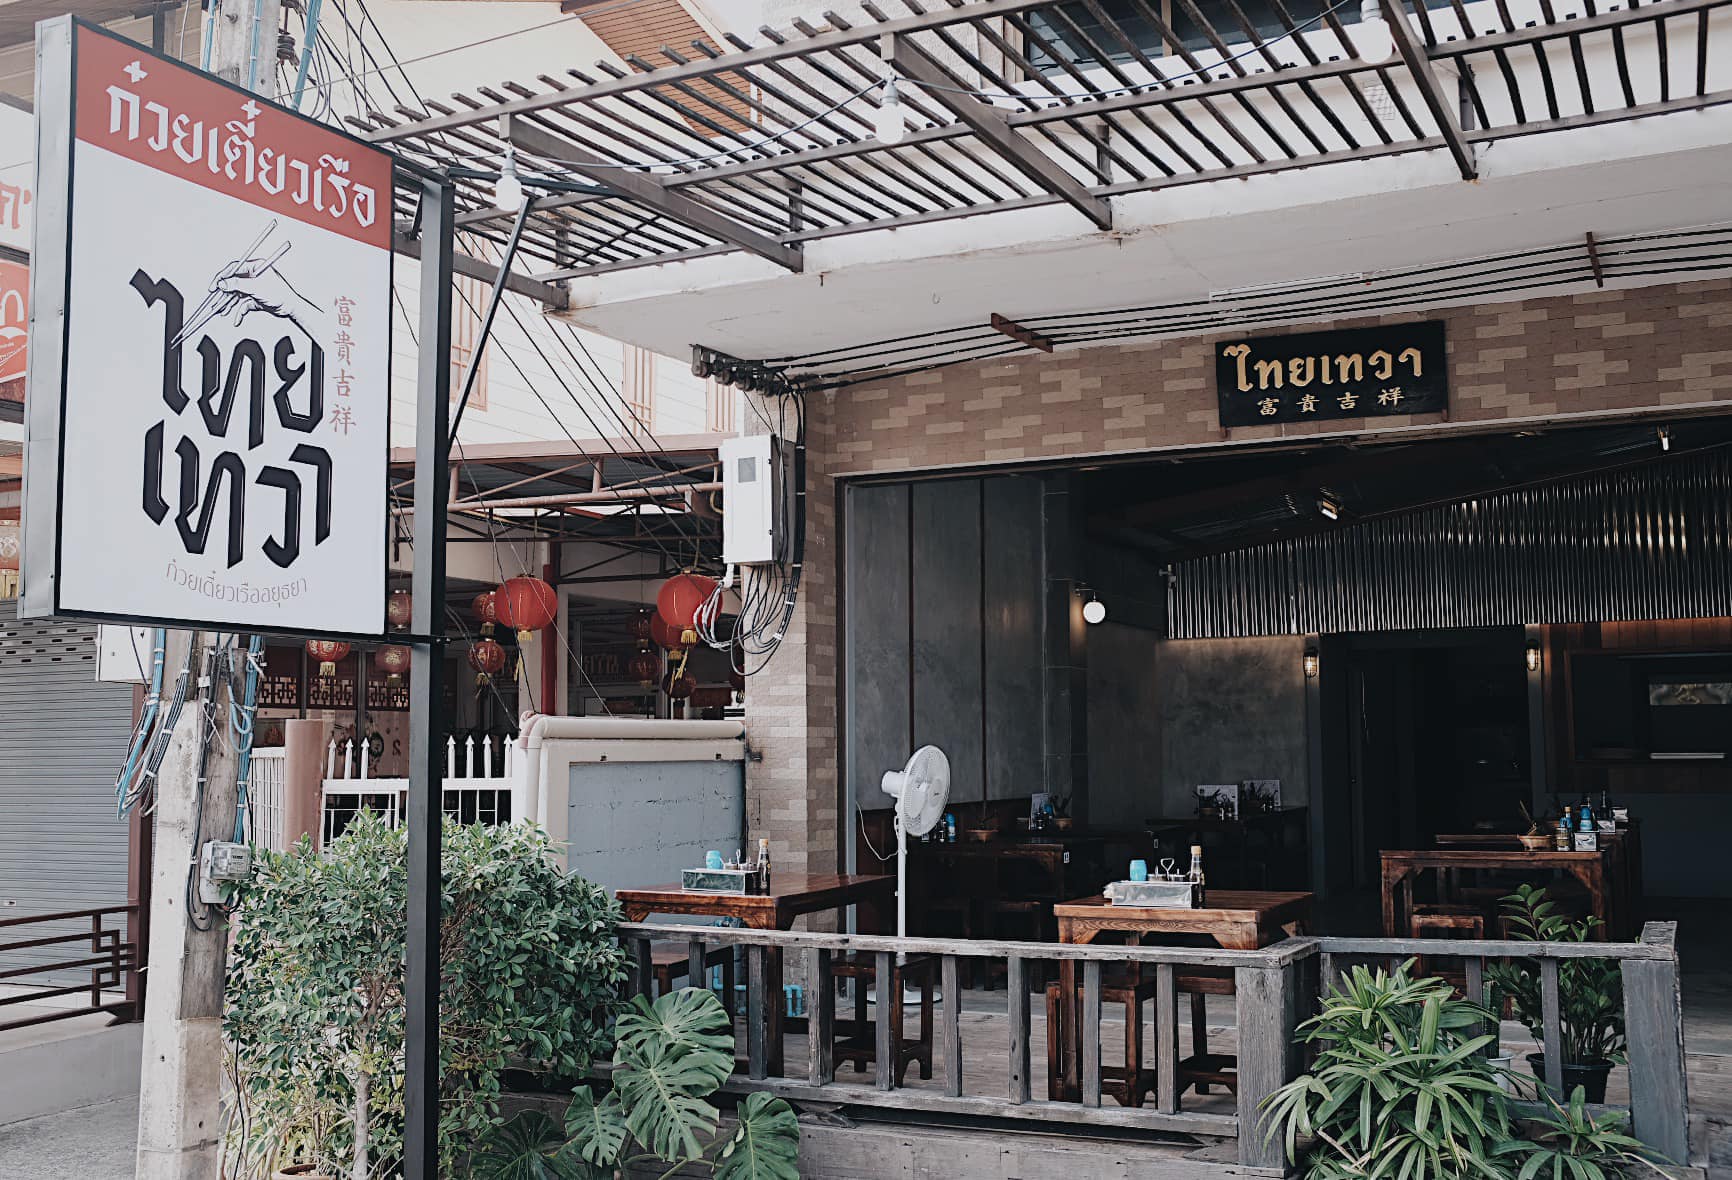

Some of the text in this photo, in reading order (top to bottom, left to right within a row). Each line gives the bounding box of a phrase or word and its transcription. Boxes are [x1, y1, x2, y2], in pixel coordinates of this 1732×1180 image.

[106, 60, 376, 229] ก๋วยเตี๋ยวเรือ
[129, 268, 325, 451] ไทย
[329, 295, 357, 436] 富貴吉祥
[1223, 343, 1423, 392] ไทยเทวา
[1257, 387, 1405, 416] 富貴吉祥
[142, 419, 333, 569] เทวา
